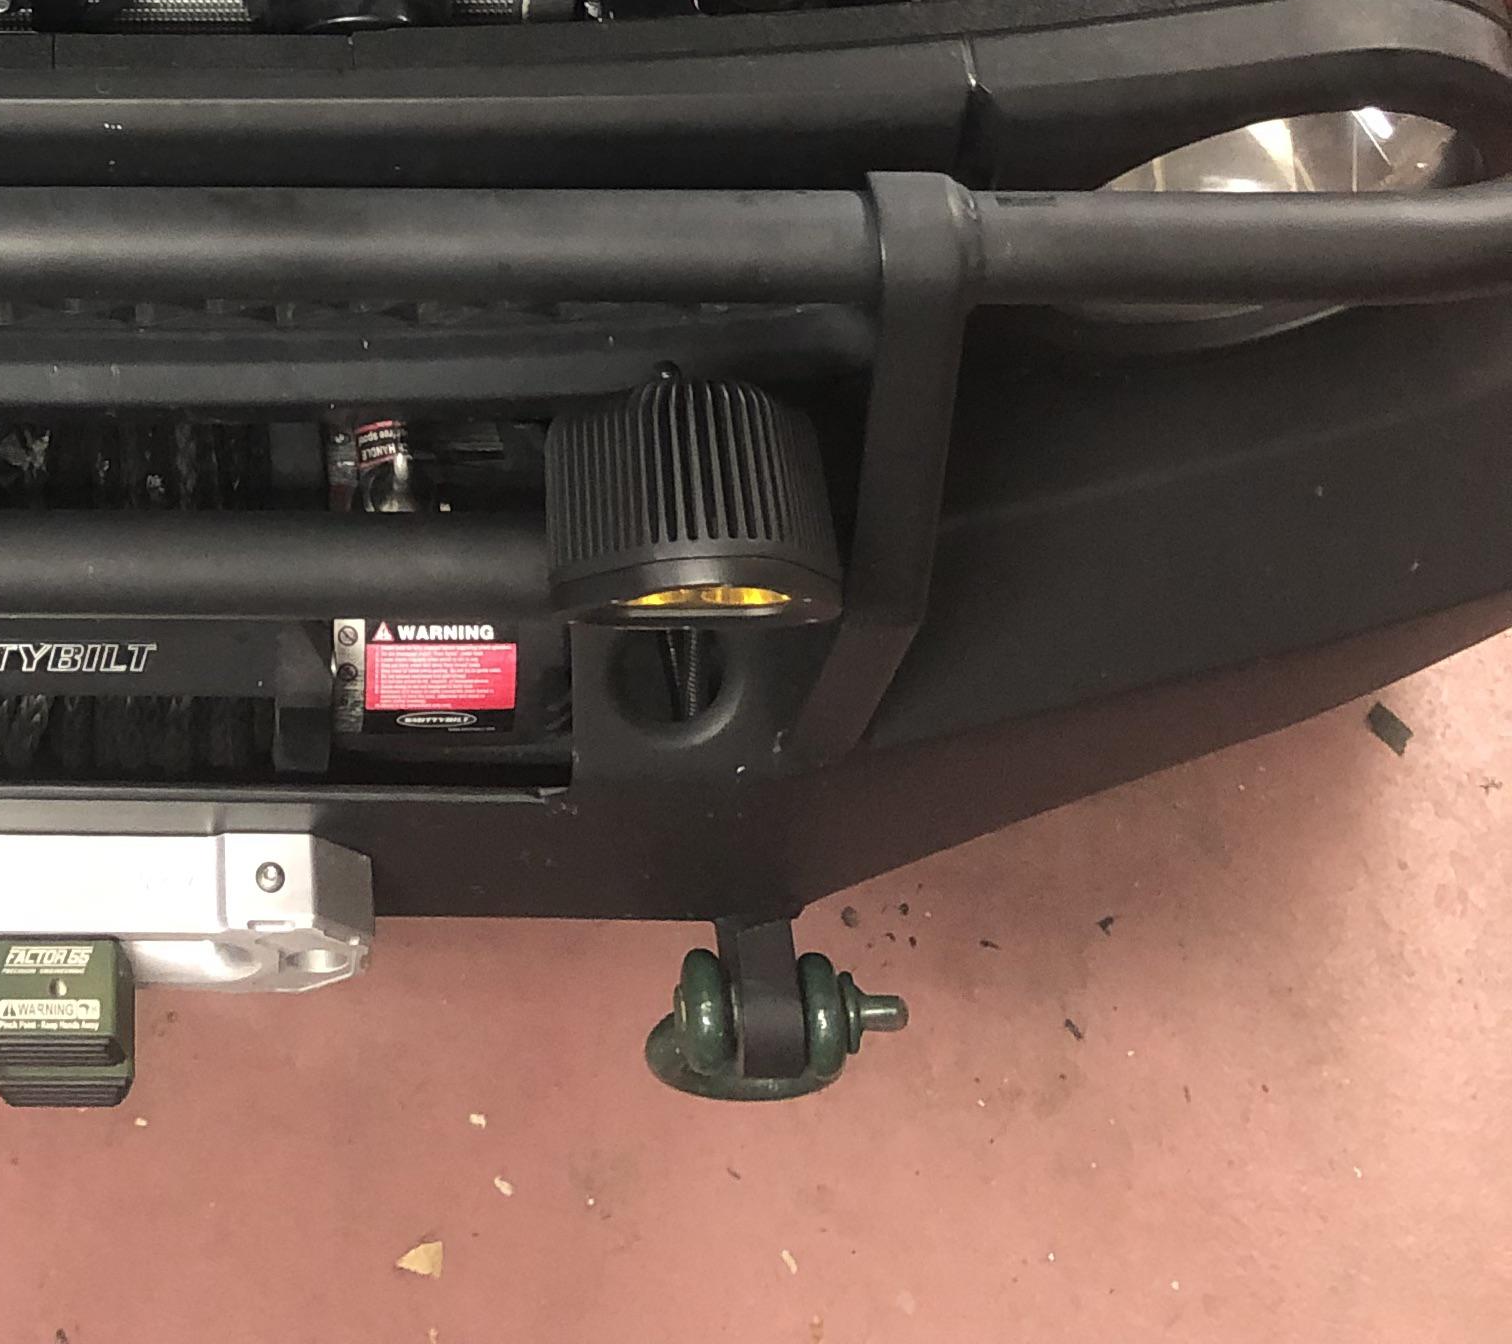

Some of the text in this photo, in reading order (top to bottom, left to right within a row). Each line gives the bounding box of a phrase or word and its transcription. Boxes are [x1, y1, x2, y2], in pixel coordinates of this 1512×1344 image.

[361, 443, 396, 461] HANDLE
[397, 624, 495, 641] WARNING
[4, 946, 69, 967] FACTOR
[17, 1003, 74, 1016] WARNING
